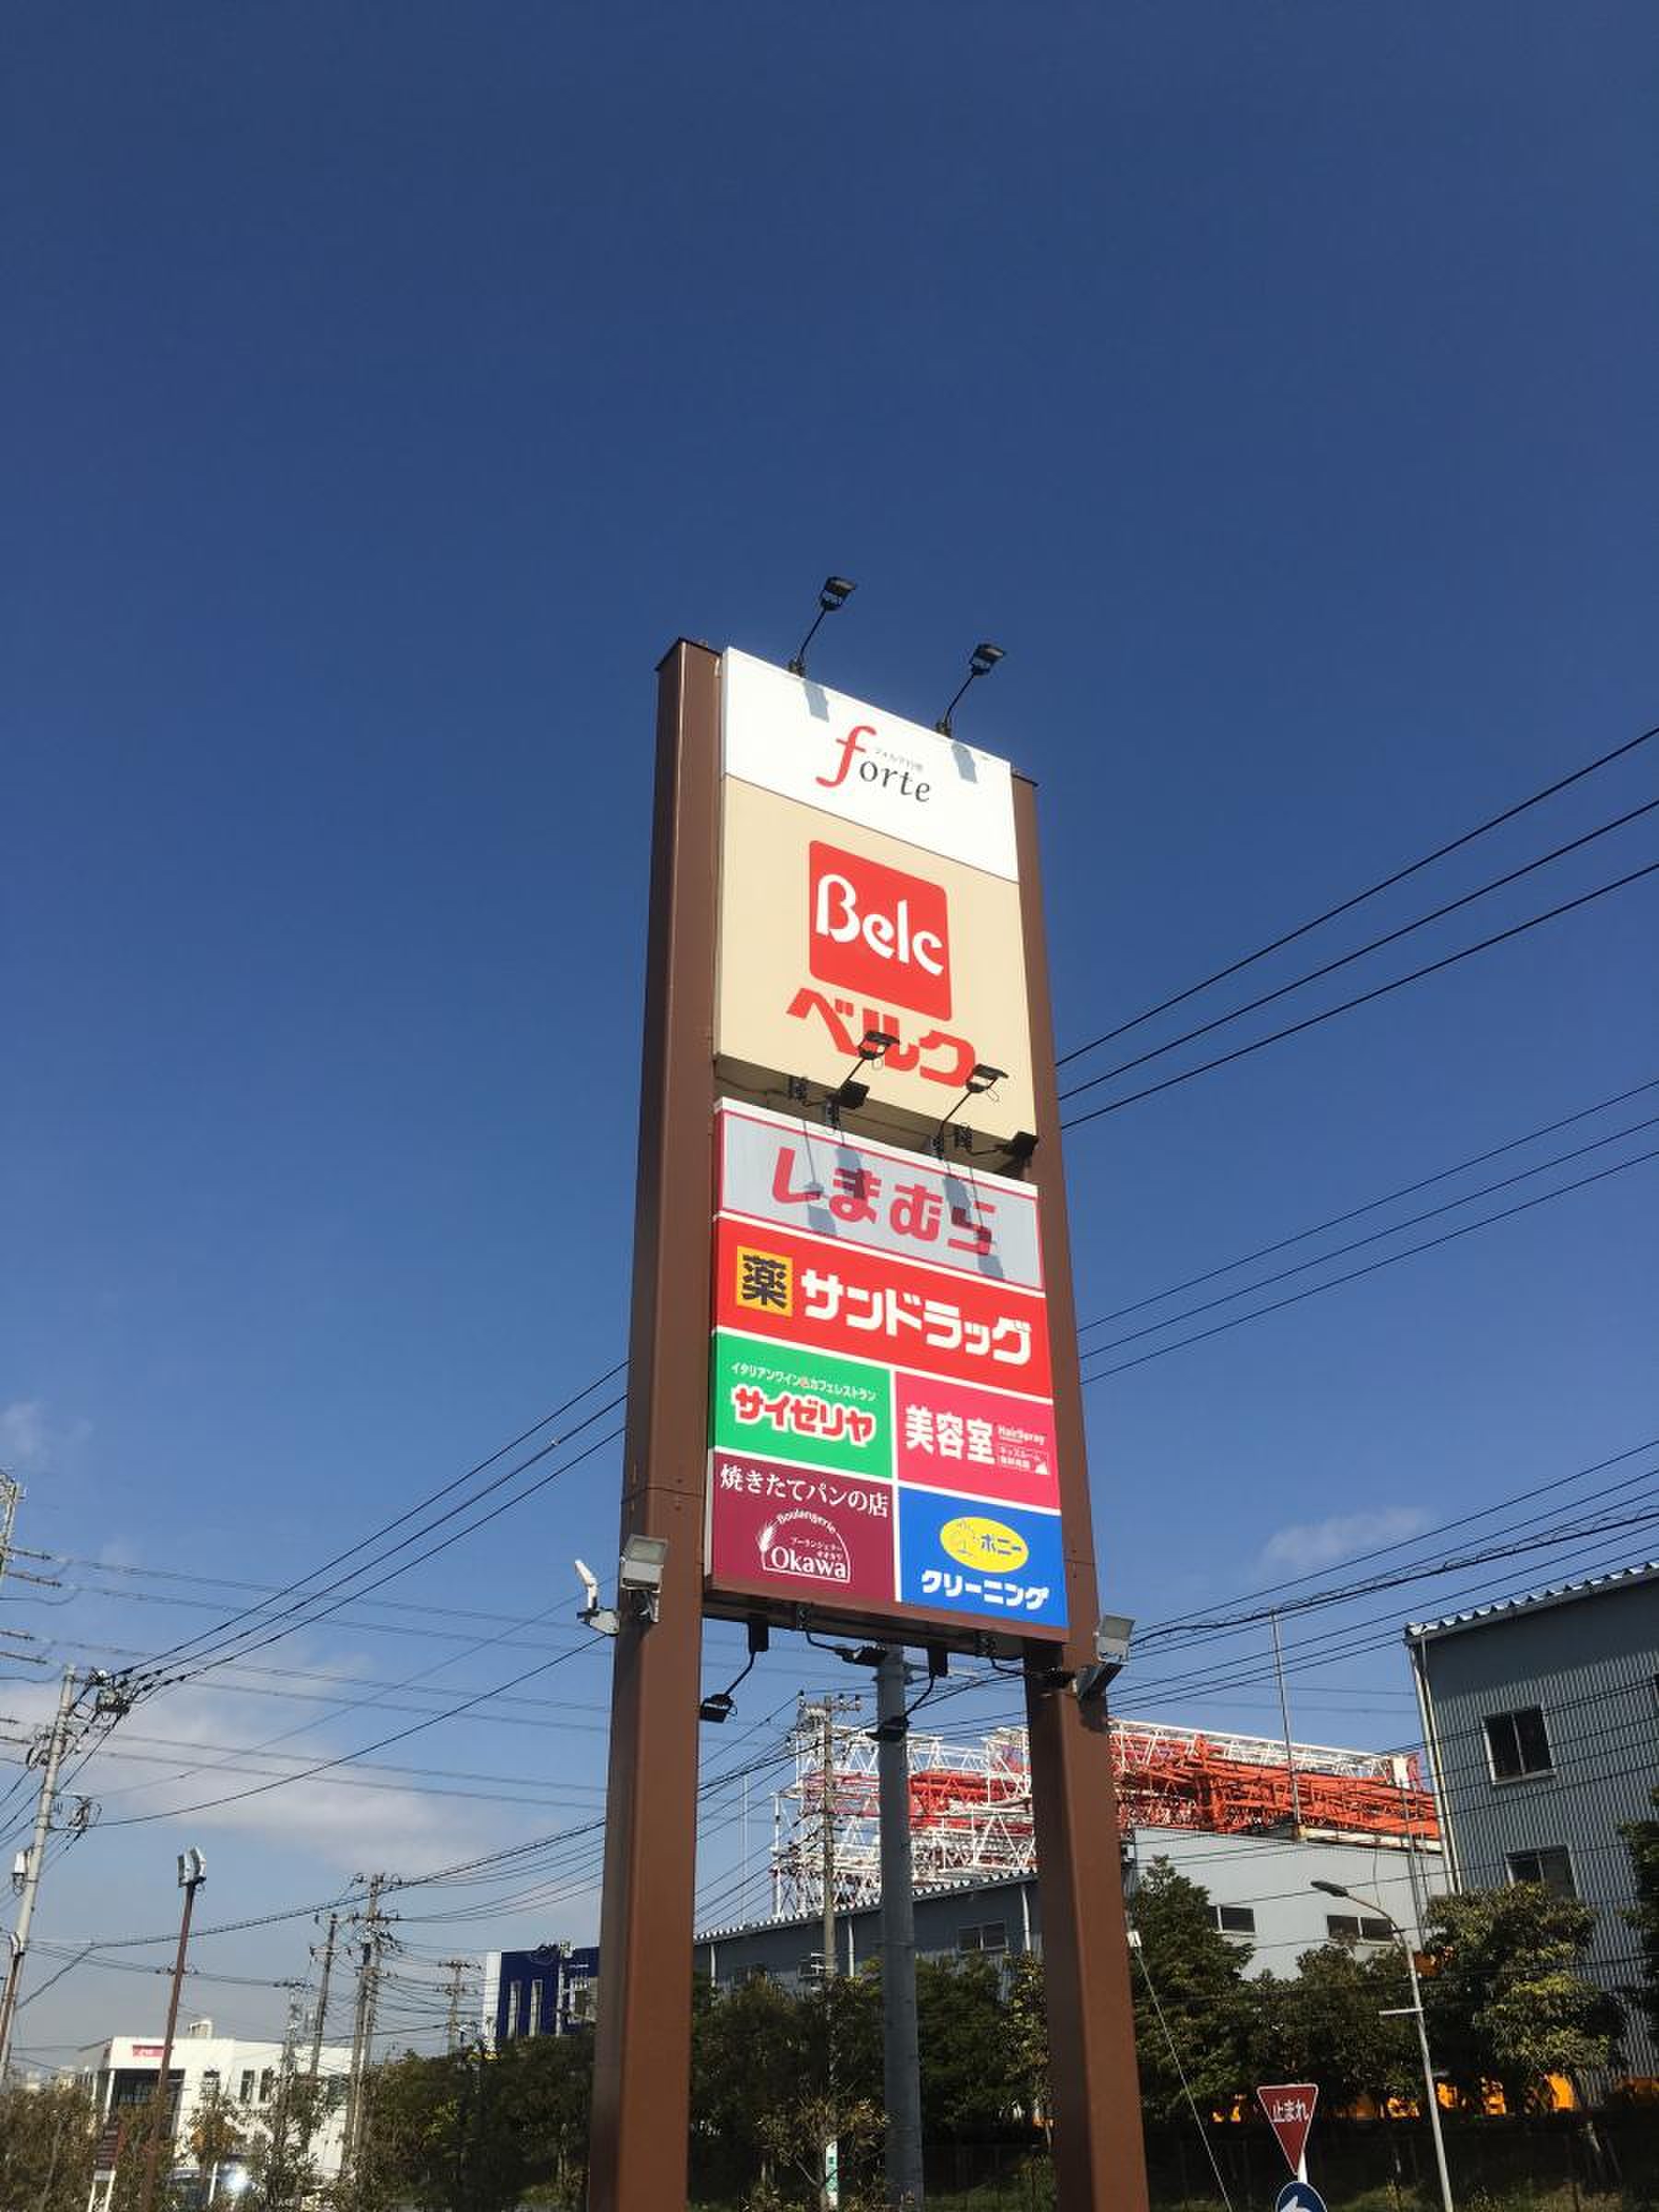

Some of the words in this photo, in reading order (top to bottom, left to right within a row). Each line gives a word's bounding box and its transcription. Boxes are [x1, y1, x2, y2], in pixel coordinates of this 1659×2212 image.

[816, 874, 945, 976] Belc
[785, 987, 976, 1088] ベルク
[771, 1147, 997, 1255] しまむら
[800, 1269, 1032, 1366] サンドラッグ
[732, 1383, 877, 1447] サイゼリヤ
[905, 1405, 996, 1465] 美容室
[720, 1464, 888, 1518] 焼きたてパンの店
[771, 1546, 847, 1579] Okawa
[921, 1569, 1049, 1610] クリーニング
[1272, 2098, 1310, 2123] 止まれ
